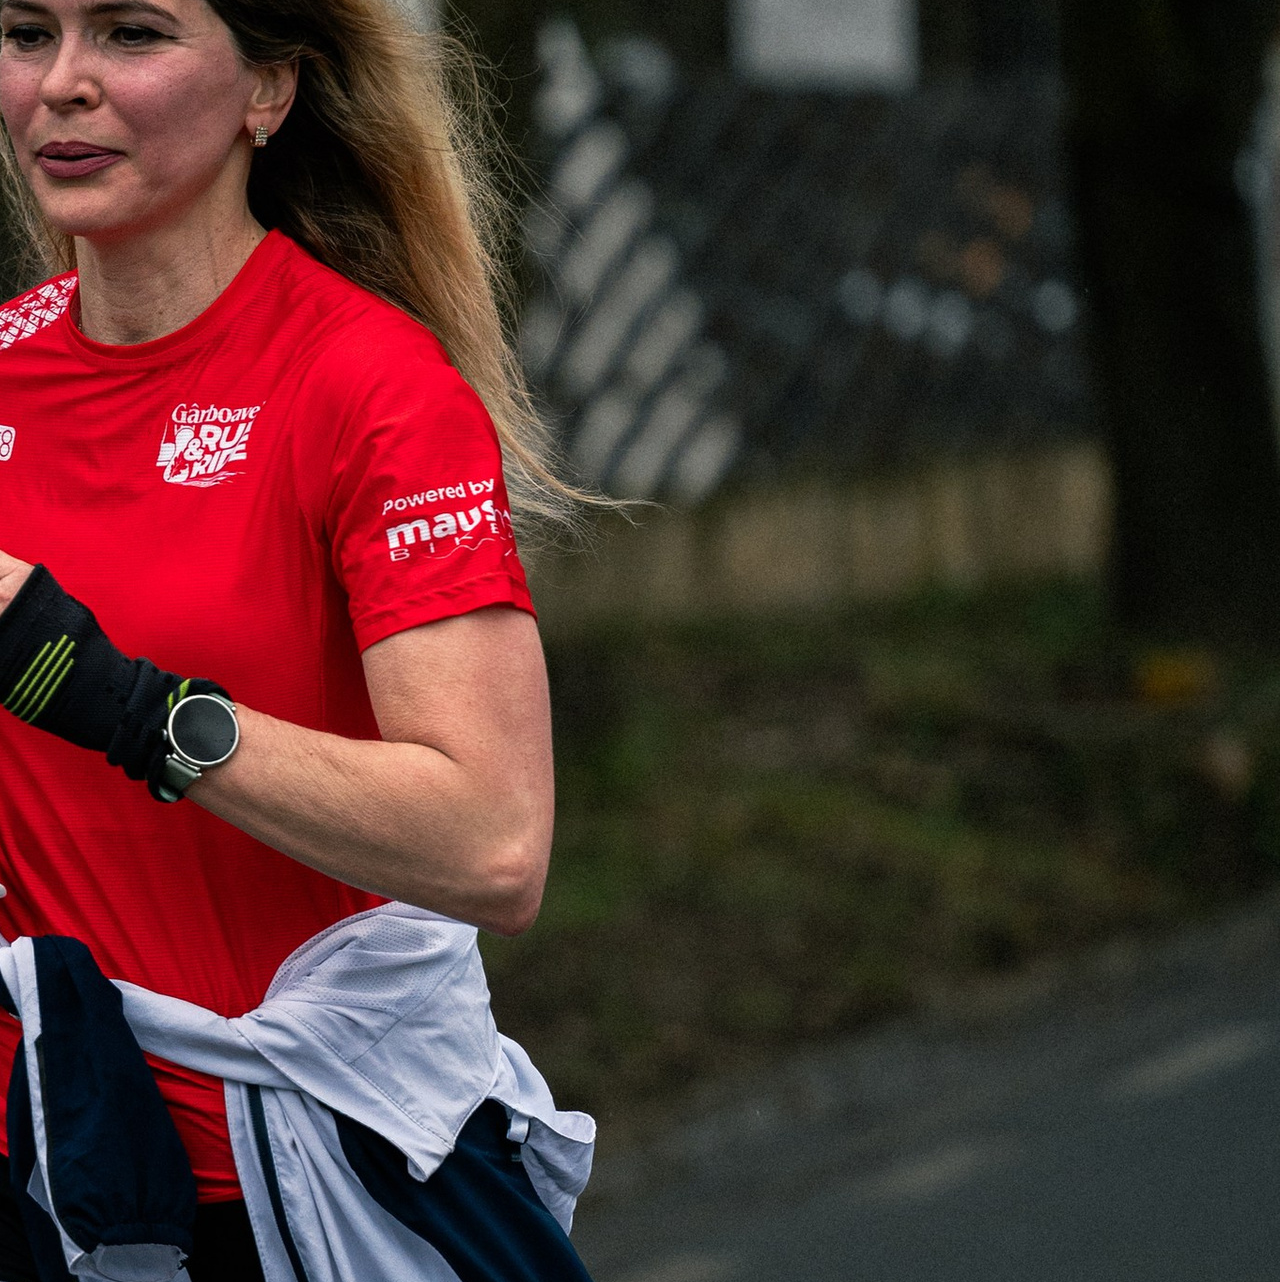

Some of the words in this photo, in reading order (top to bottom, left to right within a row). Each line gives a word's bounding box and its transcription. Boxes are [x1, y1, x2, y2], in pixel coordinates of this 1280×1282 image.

[171, 402, 263, 424] Gârboave
[183, 438, 204, 461] &
[382, 482, 466, 515] Powered
[468, 478, 494, 495] by
[386, 500, 496, 549] maus
